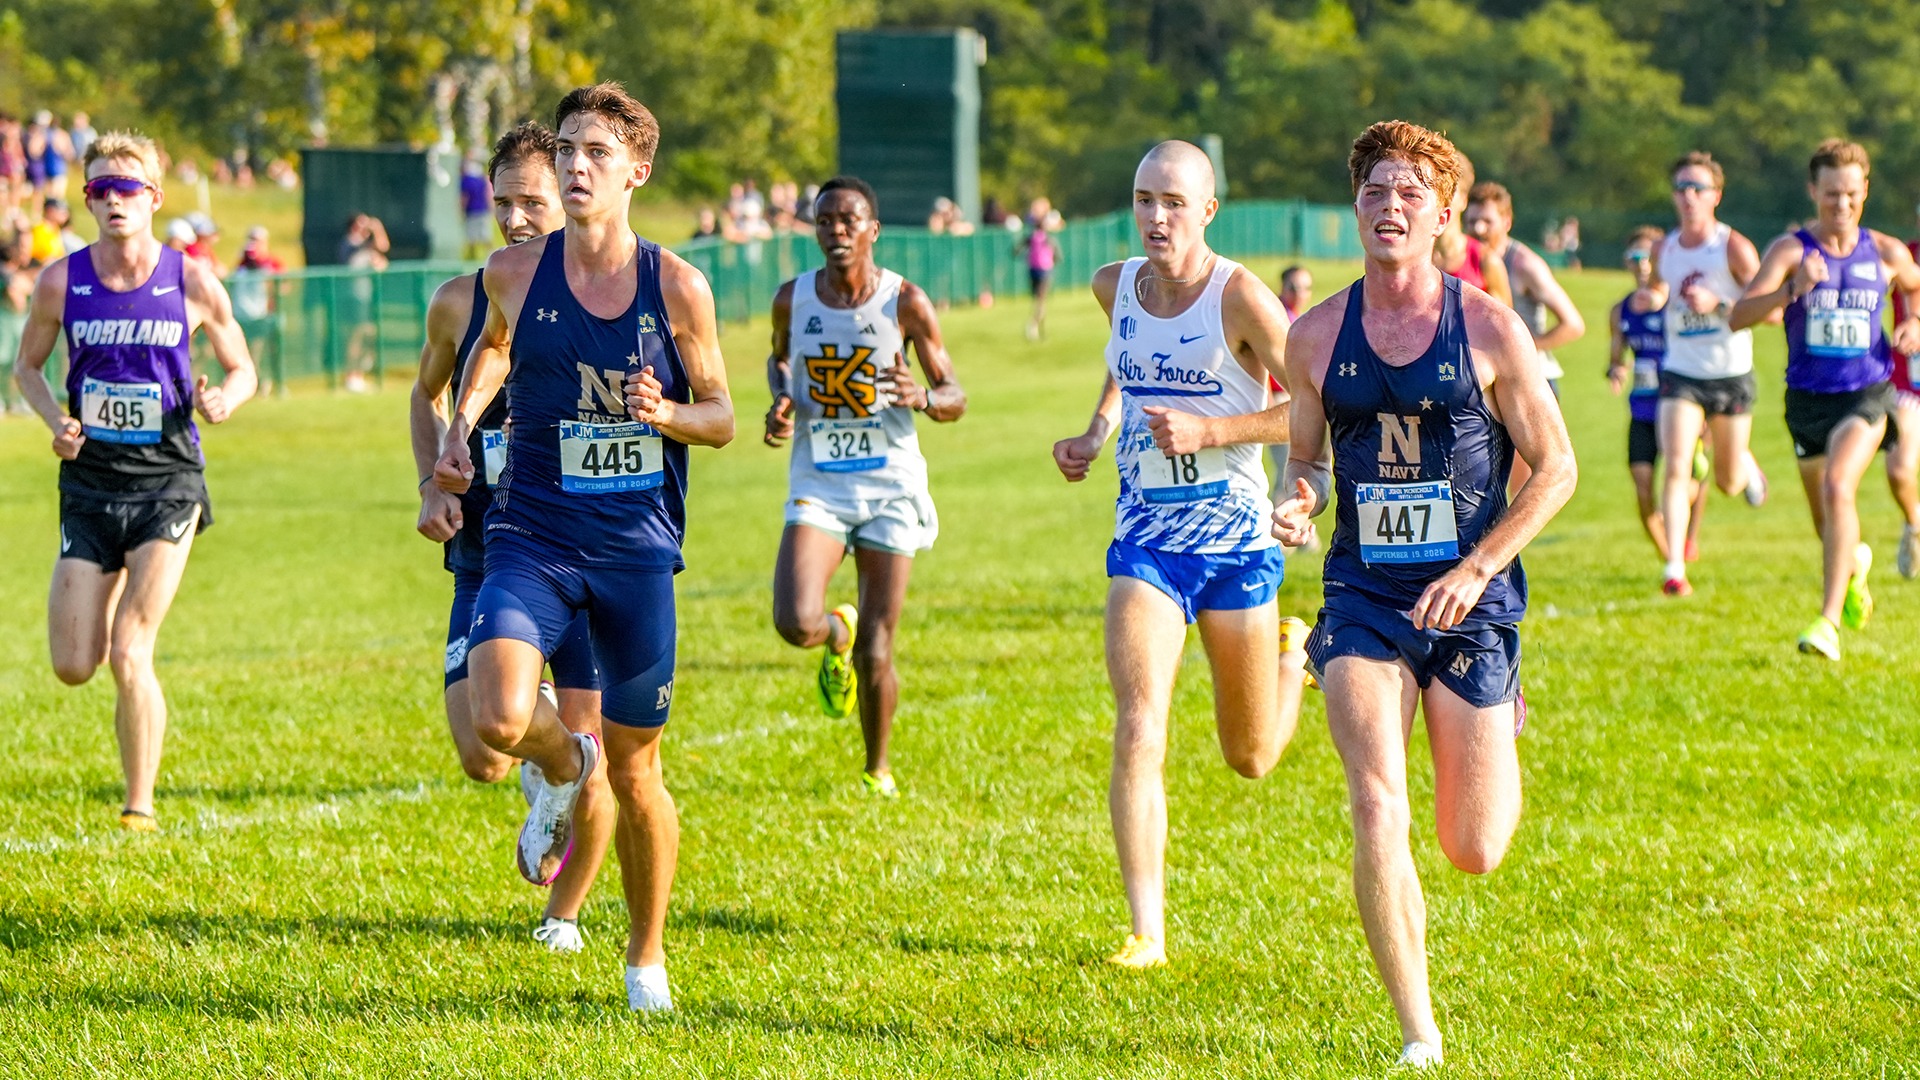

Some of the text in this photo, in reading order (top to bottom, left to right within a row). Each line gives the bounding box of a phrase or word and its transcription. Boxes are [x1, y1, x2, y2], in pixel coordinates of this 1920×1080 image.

[1841, 287, 1879, 312] STATE
[72, 319, 183, 348] PORTLAND
[1117, 350, 1215, 389] Air Force
[577, 361, 626, 415] N
[98, 400, 144, 428] 495
[576, 425, 594, 438] JM
[1377, 412, 1421, 464] N
[581, 440, 643, 476] 445
[827, 432, 872, 459] 324
[1166, 453, 1199, 485] 18
[1378, 464, 1421, 480] NAVY
[574, 481, 615, 490] SEPTEMBER
[630, 479, 651, 488] 2026
[1199, 487, 1218, 496] 2026
[1369, 488, 1386, 501] JM
[1376, 504, 1431, 543] 447
[1371, 551, 1409, 559] SEPTEMBER
[1424, 548, 1445, 557] 2026
[1451, 651, 1474, 675] N
